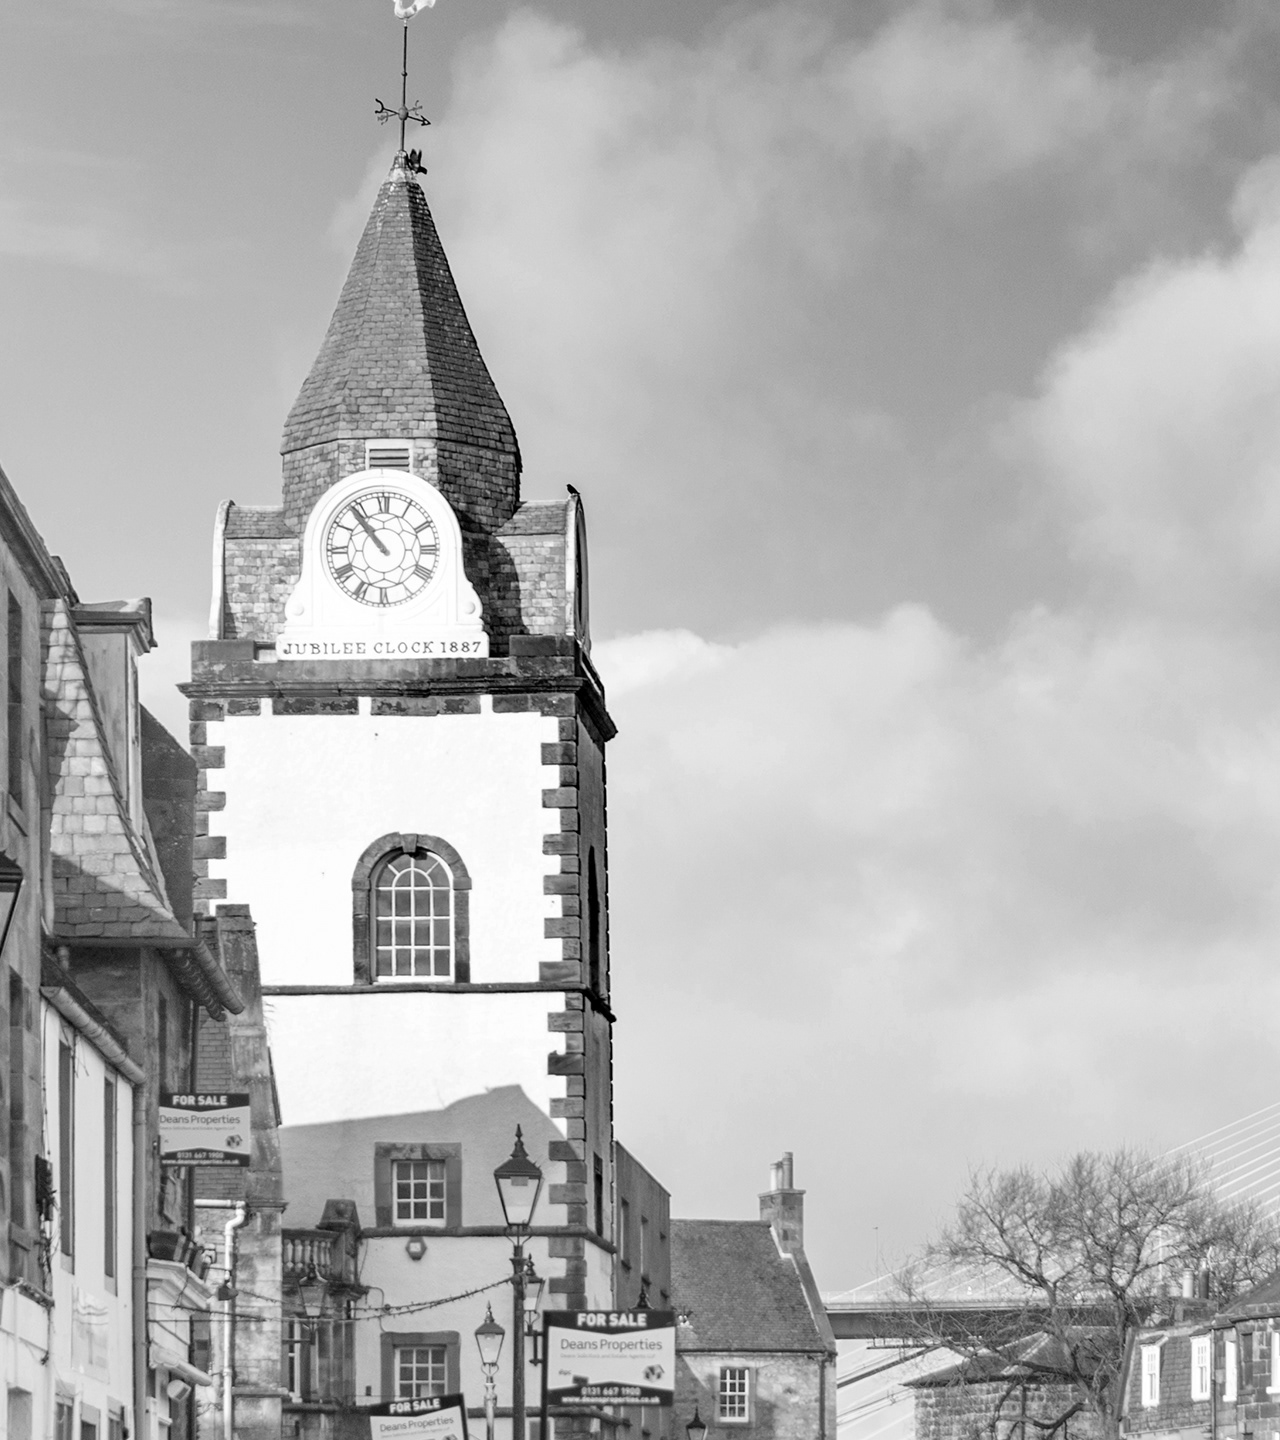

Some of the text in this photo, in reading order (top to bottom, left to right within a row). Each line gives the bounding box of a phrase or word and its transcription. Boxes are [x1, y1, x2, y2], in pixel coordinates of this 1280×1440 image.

[283, 641, 482, 655] JUBILEE CLOCK 1887
[172, 1095, 228, 1106] FOR SALE
[160, 1114, 241, 1125] Deans Properties
[577, 1312, 648, 1327] FOR SALE
[560, 1338, 663, 1353] Deans Properties
[581, 1386, 601, 1396] 0131
[602, 1386, 620, 1396] 667
[389, 1398, 441, 1414] FOR SALE
[380, 1416, 455, 1432] Deans Properties
